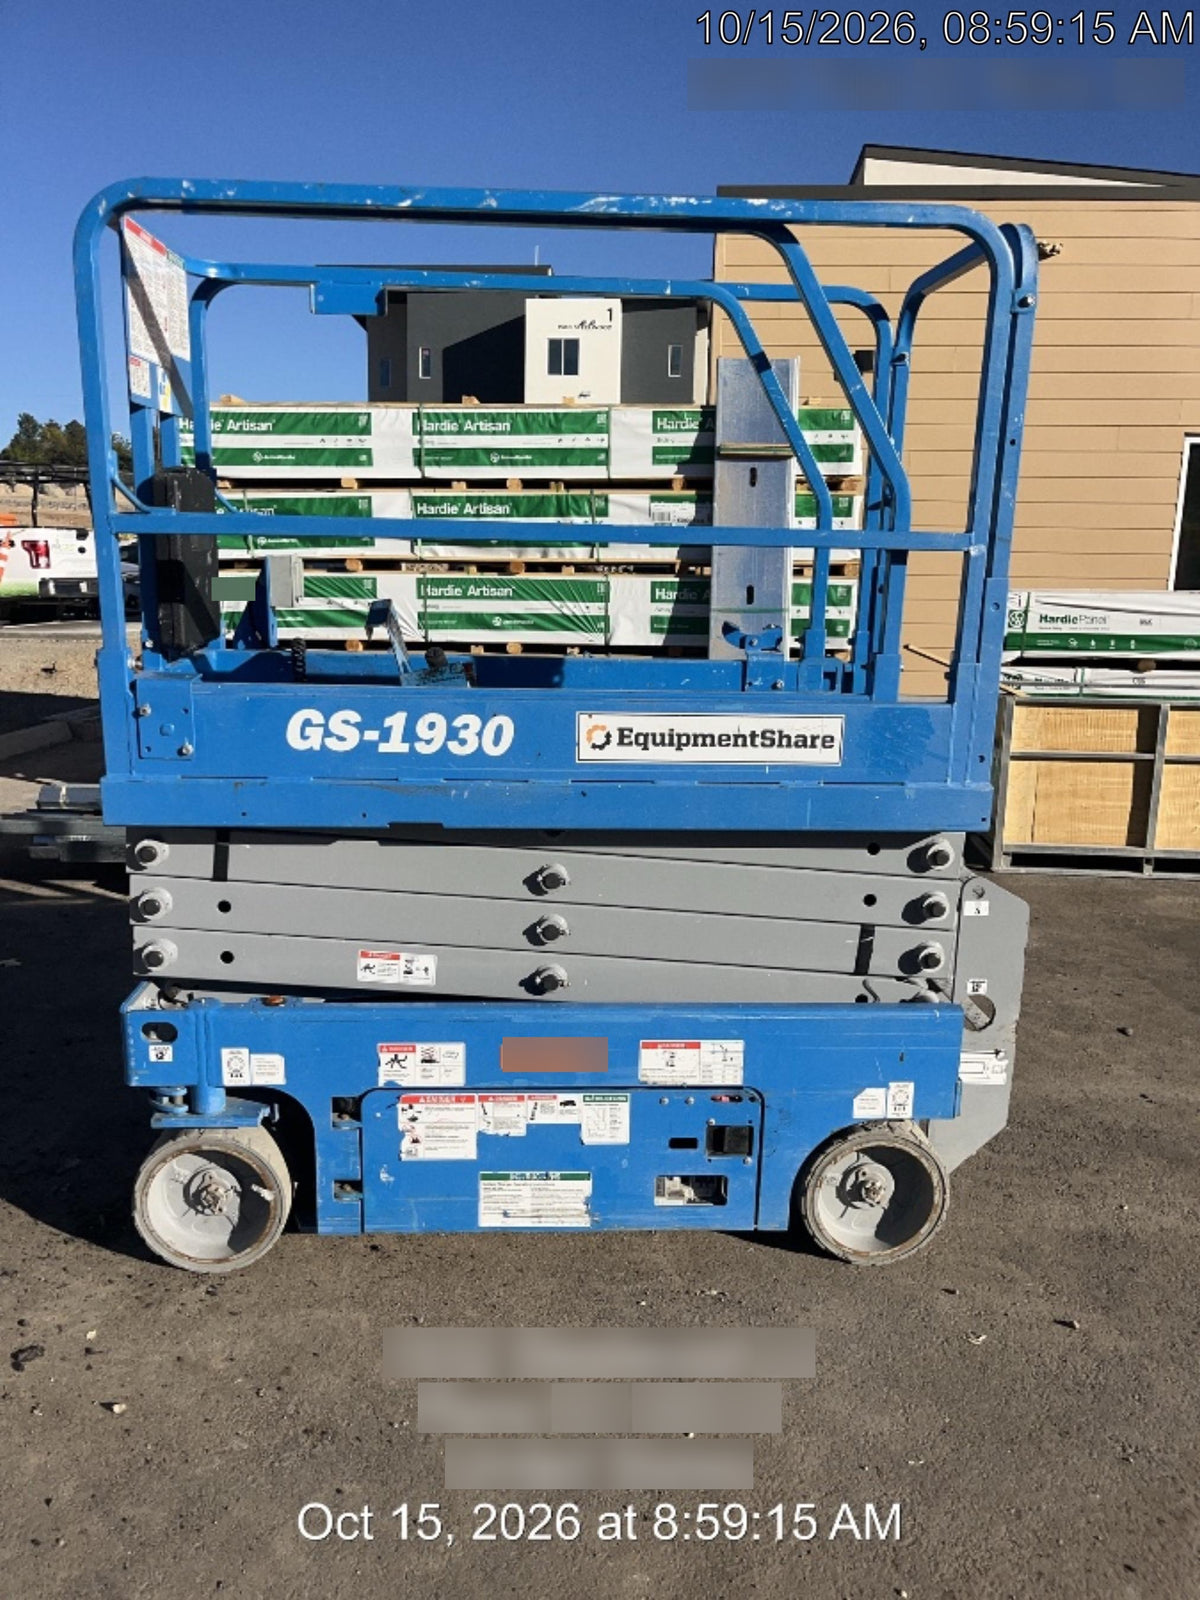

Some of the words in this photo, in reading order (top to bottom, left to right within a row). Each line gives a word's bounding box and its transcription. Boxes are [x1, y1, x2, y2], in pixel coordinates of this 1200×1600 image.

[606, 307, 614, 322] 1
[227, 418, 273, 431] Artisan
[464, 419, 511, 432] Artisan
[656, 417, 699, 430] Hardie
[417, 502, 459, 514] Hardie
[463, 502, 510, 514] Artisan
[420, 584, 463, 596] Hardie
[467, 584, 513, 596] Artisan
[655, 588, 698, 600] Hardie
[286, 709, 514, 757] GS-1930
[617, 727, 835, 751] EquipmentShare
